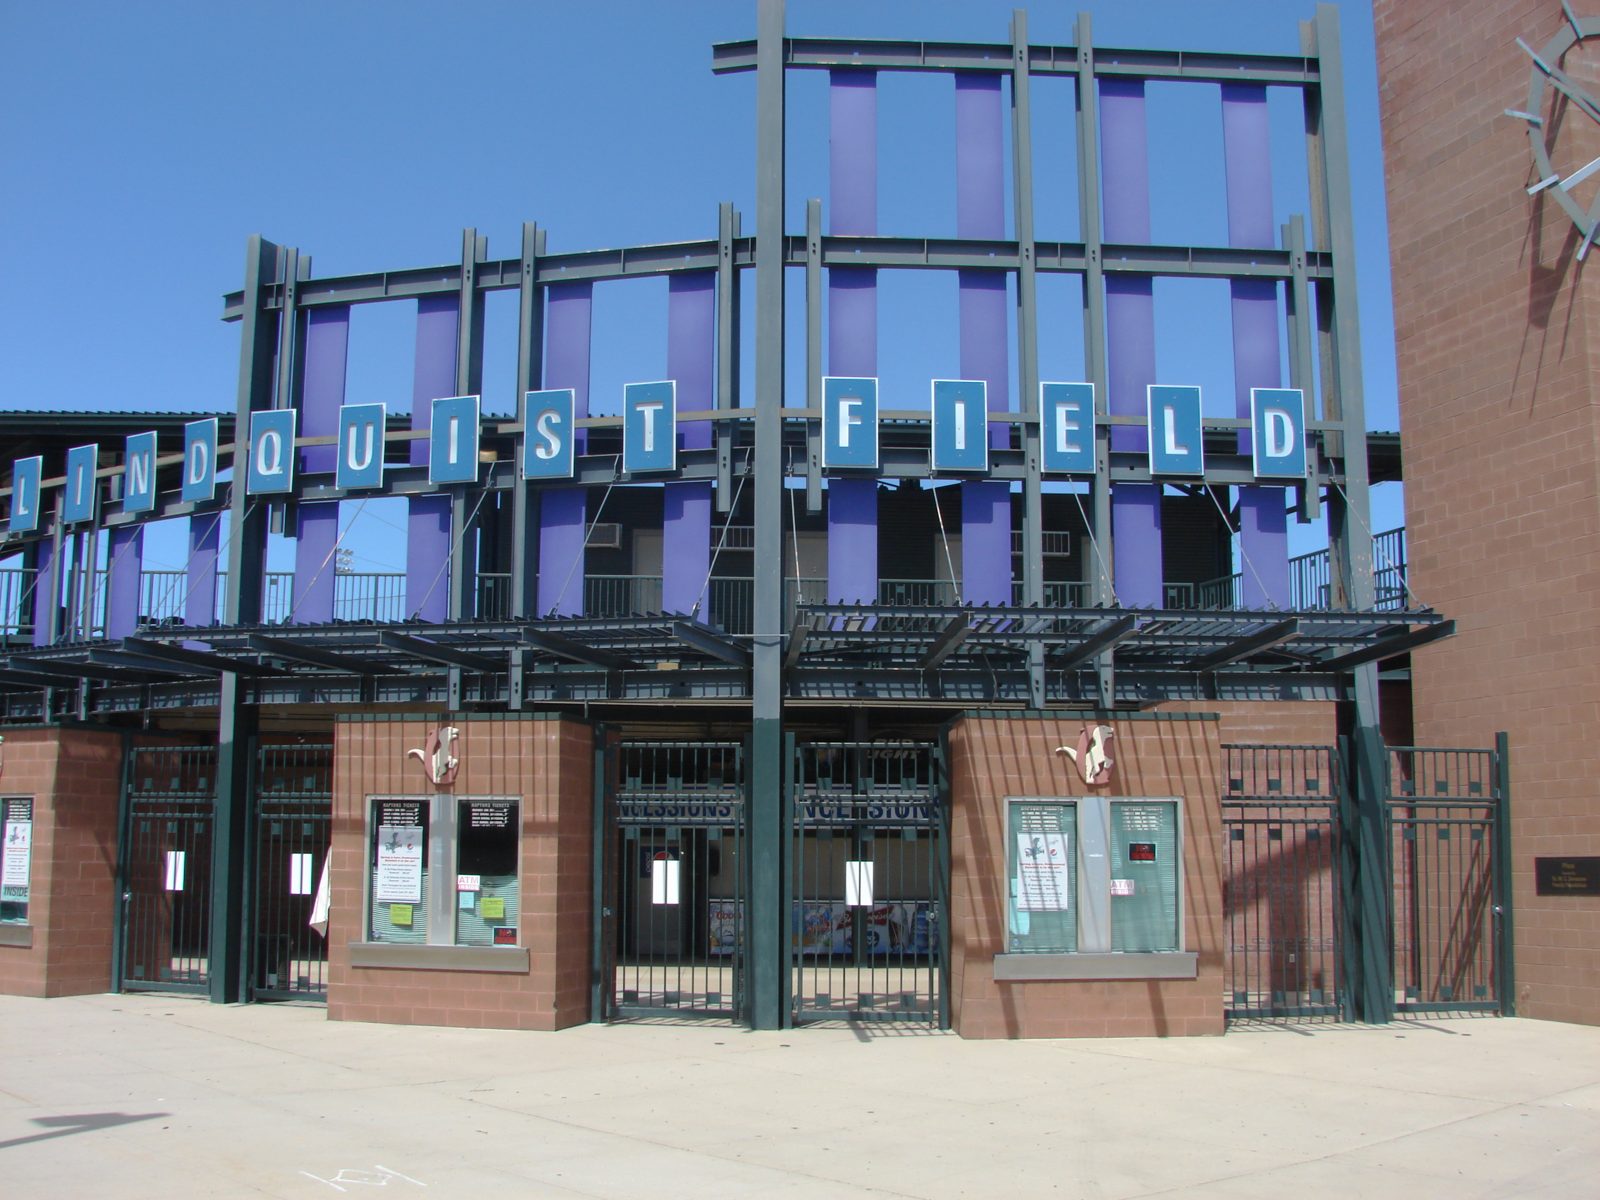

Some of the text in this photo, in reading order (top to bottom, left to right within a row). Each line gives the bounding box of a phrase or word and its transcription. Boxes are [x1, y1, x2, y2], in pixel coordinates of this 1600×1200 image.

[19, 400, 1295, 515] LINDQUIST FIELD
[459, 876, 479, 884] ATM
[4, 886, 28, 897] INSIDE
